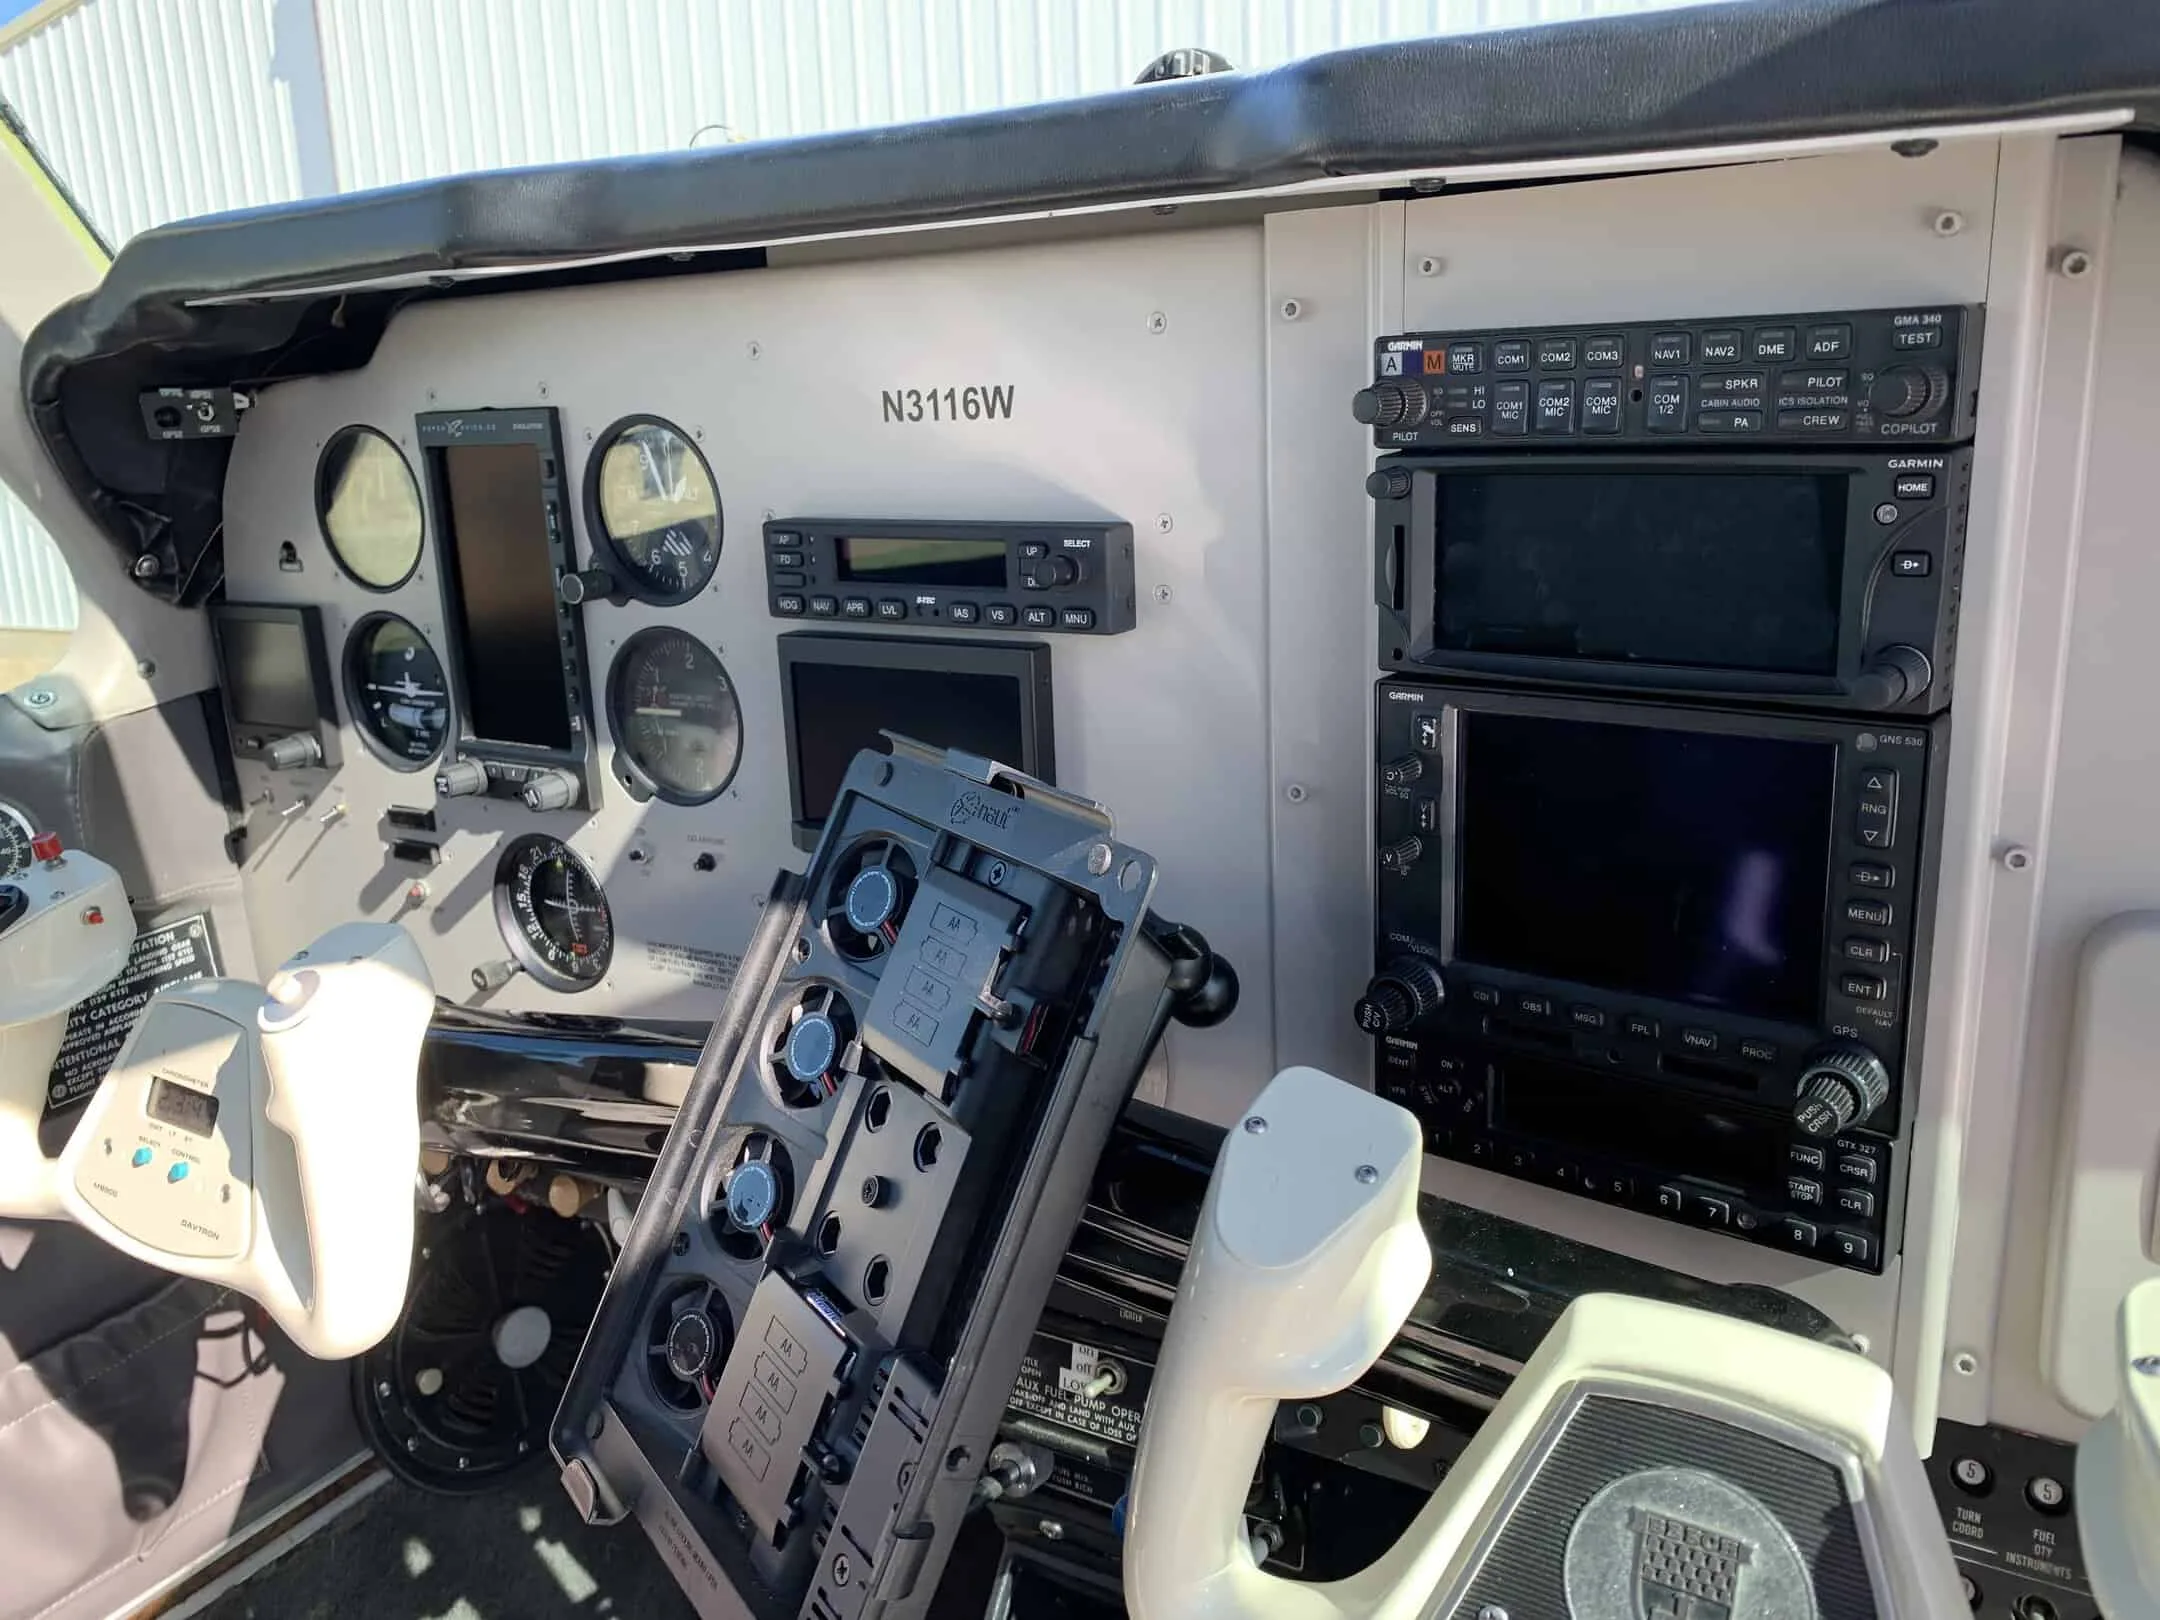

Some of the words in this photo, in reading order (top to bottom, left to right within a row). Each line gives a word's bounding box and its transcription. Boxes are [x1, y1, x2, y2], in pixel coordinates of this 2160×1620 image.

[1894, 315, 1919, 326] GMA
[1922, 314, 1942, 324] 340
[1900, 332, 1934, 345] TEST
[1705, 346, 1735, 357] NAV2
[1758, 344, 1785, 355] DME
[1813, 342, 1840, 353] ADF
[1452, 353, 1474, 364] MKR
[1497, 354, 1525, 365] COM1
[1540, 351, 1571, 363] COM2
[1586, 350, 1618, 361] COM3
[1654, 350, 1680, 360] NAV1
[1384, 356, 1398, 373] A
[1426, 355, 1442, 370] M
[1725, 379, 1758, 389] SPKR
[1807, 377, 1843, 388] PILOT
[1473, 386, 1485, 396] HI
[882, 384, 1015, 423] N3116W
[1472, 399, 1486, 410] LO
[1539, 396, 1570, 408] COM2
[1585, 395, 1617, 407] COM3
[1654, 394, 1680, 404] COM
[1730, 398, 1760, 407] AUDIO
[1778, 396, 1795, 406] ICS
[1797, 395, 1848, 406] ISOLATION
[1496, 401, 1523, 411] COM1
[1544, 407, 1564, 417] MIC
[1591, 405, 1611, 415] MIC
[1659, 404, 1674, 415] 1/2
[1502, 410, 1519, 421] MIC
[1802, 415, 1840, 426] CREW
[1450, 423, 1477, 434] SENS
[1733, 417, 1749, 428] PA
[1880, 423, 1938, 435] COPILOT
[1392, 432, 1419, 442] PILOT
[1887, 458, 1944, 469] GARMIN
[1897, 482, 1928, 493] HOME
[650, 549, 662, 565] 6
[703, 551, 712, 562] 4
[1026, 546, 1038, 556] UP
[678, 561, 688, 577] 5
[779, 598, 798, 610] HDG
[845, 600, 864, 613] APR
[881, 603, 898, 615] LVL
[953, 607, 969, 619] IAS
[991, 609, 1005, 621] VS
[1027, 611, 1044, 623] ALT
[1065, 612, 1088, 625] MNU
[685, 654, 695, 670] 2
[717, 675, 728, 691] 3
[1388, 691, 1424, 702] GARMIN
[1861, 803, 1887, 815] RNG
[1848, 908, 1882, 922] MENU
[131, 930, 175, 953] ITATION
[1850, 944, 1873, 958] CLR
[1848, 982, 1872, 996] ENT
[90, 991, 148, 1021] CATEGORY
[1856, 1006, 1893, 1018] DEFAULT
[1631, 1023, 1649, 1035] FPL
[1832, 1026, 1858, 1039] GPS
[1684, 1033, 1712, 1048] VNAV
[54, 1037, 121, 1070] TENTIONAL
[1742, 1045, 1774, 1060] PROC
[1441, 1058, 1454, 1070] ON
[1797, 1103, 1824, 1123] PUSH
[1808, 1110, 1833, 1133] CRSR
[1473, 1143, 1482, 1155] 2
[1837, 1138, 1857, 1150] GTX
[1514, 1155, 1522, 1166] 3
[1790, 1151, 1819, 1166] FUNC
[1556, 1166, 1565, 1178] 4
[1839, 1163, 1869, 1178] CRSR
[1614, 1181, 1623, 1193] 5
[1788, 1181, 1816, 1193] START
[1660, 1194, 1668, 1205] 6
[1790, 1190, 1814, 1202] STOP
[1840, 1198, 1862, 1211] CLR
[1709, 1206, 1718, 1218] 7
[180, 1218, 220, 1241] DAVTRON
[1794, 1229, 1803, 1241] 8
[1844, 1242, 1854, 1254] 9
[1016, 1375, 1040, 1393] AUX
[1045, 1384, 1069, 1401] FUEL
[1074, 1395, 1106, 1411] PUMP
[1111, 1405, 1142, 1425] OPER
[1025, 1401, 1053, 1416] EXCEPT
[1055, 1410, 1065, 1421] IN
[1067, 1415, 1087, 1428] CASE
[1090, 1422, 1101, 1431] OF
[1103, 1426, 1123, 1439] LOSS
[1069, 1405, 1091, 1418] LAND
[1094, 1413, 1115, 1426] WITH
[1118, 1420, 1136, 1433] AUX
[1966, 1462, 1977, 1479] 5
[2042, 1483, 2053, 1501] 5
[1957, 1507, 1982, 1525] TURN
[1952, 1521, 1984, 1539] COORD
[2033, 1528, 2057, 1546] FUEL
[2034, 1542, 2054, 1558] QTY
[2005, 1551, 2072, 1580] INSTRUMENTS
